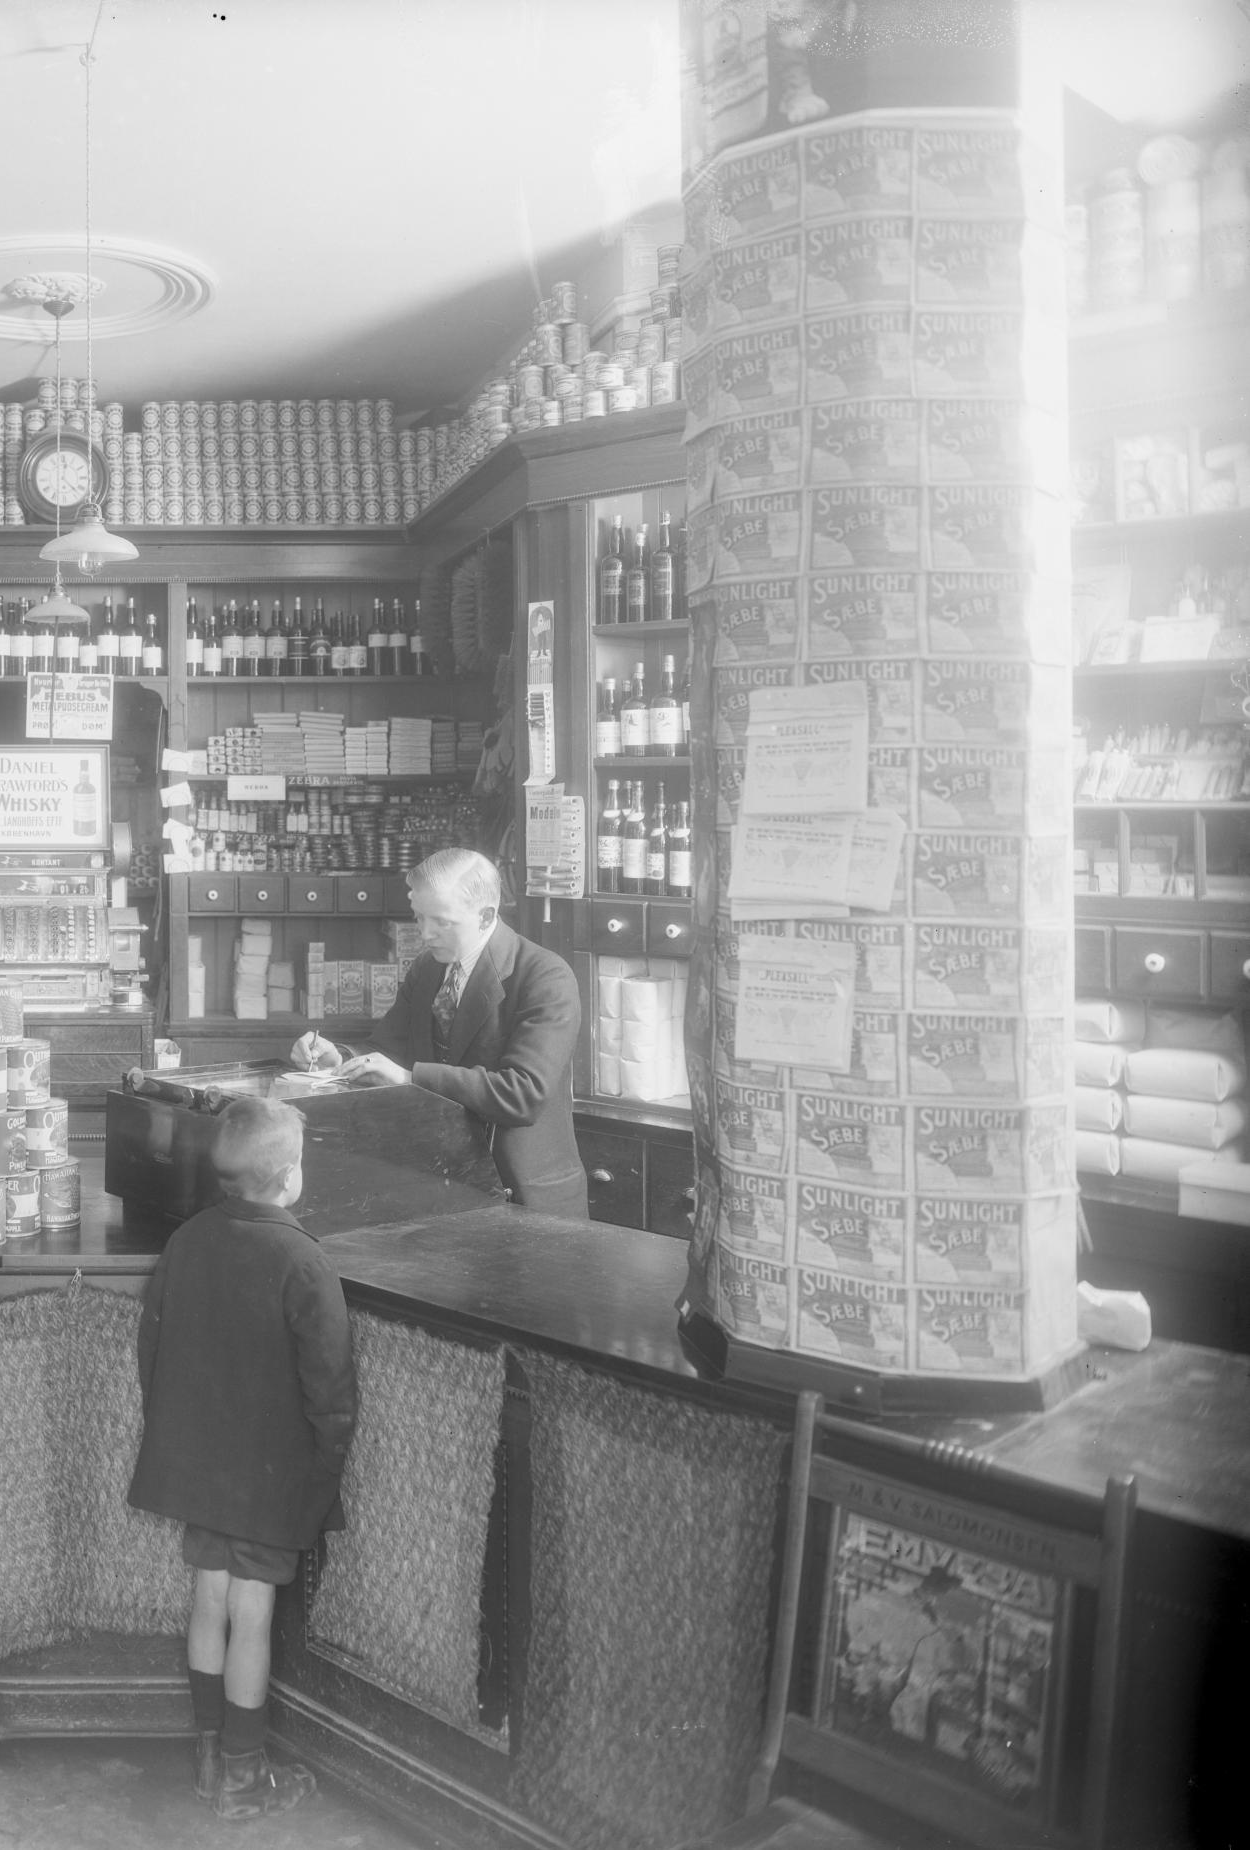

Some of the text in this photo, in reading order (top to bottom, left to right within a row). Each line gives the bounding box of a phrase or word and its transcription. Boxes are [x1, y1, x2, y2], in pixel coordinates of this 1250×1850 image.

[809, 130, 908, 165] SUNLIGHT
[809, 219, 910, 257] SUNLIGHT
[809, 314, 911, 350] SUNLIGHT
[819, 340, 876, 374] SÆBE
[722, 357, 765, 392] SÆBE
[816, 401, 918, 430] SUNLIGHT
[825, 423, 880, 455] SÆBE
[817, 488, 918, 516] SUNLIGHT
[722, 519, 765, 550] SÆBE
[826, 510, 880, 539] SÆBE
[813, 574, 912, 604] SUNLIGHT
[932, 574, 1027, 600] SUNLIGHT
[823, 600, 877, 630] SÆBE
[941, 600, 993, 627] SÆBE
[809, 661, 908, 687] SUNLIGHT
[926, 661, 1024, 688] SUNLIGHT
[936, 685, 990, 715] SÆBE
[0, 757, 59, 774] DANIEL
[922, 747, 1020, 774] SUNLIGHT
[288, 776, 331, 786] ZEBRA
[933, 772, 987, 800] SÆBE
[918, 834, 1015, 863] SUNLIGHT
[927, 857, 982, 888] SÆBE
[800, 922, 899, 945] SUNLIGHT
[918, 925, 1017, 952] SUNLIGHT
[928, 952, 982, 981] SÆBE
[912, 1014, 1009, 1038] SUNLIGHT
[921, 1037, 976, 1068] SÆBE
[801, 1096, 900, 1126] SUNLIGHT
[919, 1108, 1019, 1136] SUNLIGHT
[810, 1127, 863, 1151] SÆBE
[929, 1135, 983, 1163] SÆBE
[801, 1186, 900, 1218] SUNLIGHT
[920, 1200, 1018, 1228] SUNLIGHT
[811, 1219, 865, 1241] SÆBE
[929, 1230, 982, 1256] SÆBE
[803, 1271, 900, 1303] SUNLIGHT
[921, 1289, 1015, 1313] SUNLIGHT
[812, 1303, 865, 1325] SÆBE
[930, 1313, 983, 1341] SÆBE
